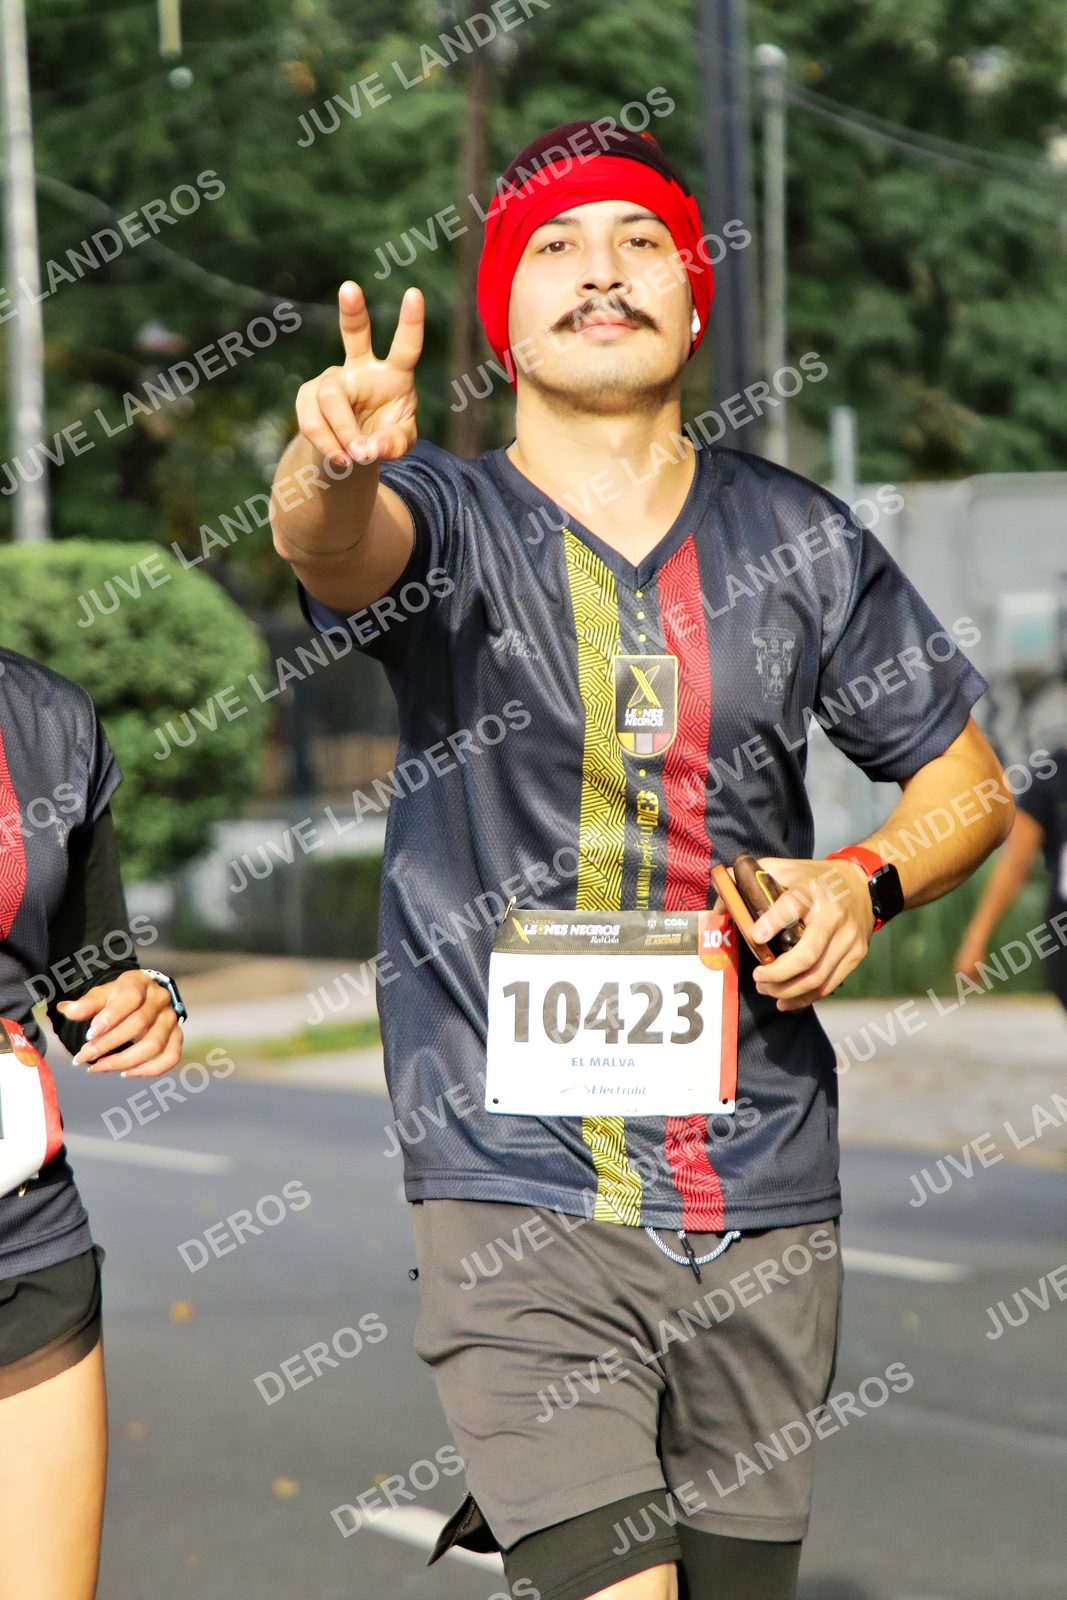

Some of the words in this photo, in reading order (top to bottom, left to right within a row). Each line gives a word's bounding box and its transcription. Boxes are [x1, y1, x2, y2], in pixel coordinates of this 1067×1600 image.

[625, 717, 664, 726] NEGROS
[524, 924, 569, 935] LEONES
[569, 924, 620, 935] NEGROS
[703, 929, 732, 948] 10K
[502, 980, 705, 1045] 10423
[571, 1057, 585, 1067] EL
[589, 1057, 636, 1068] MALVA
